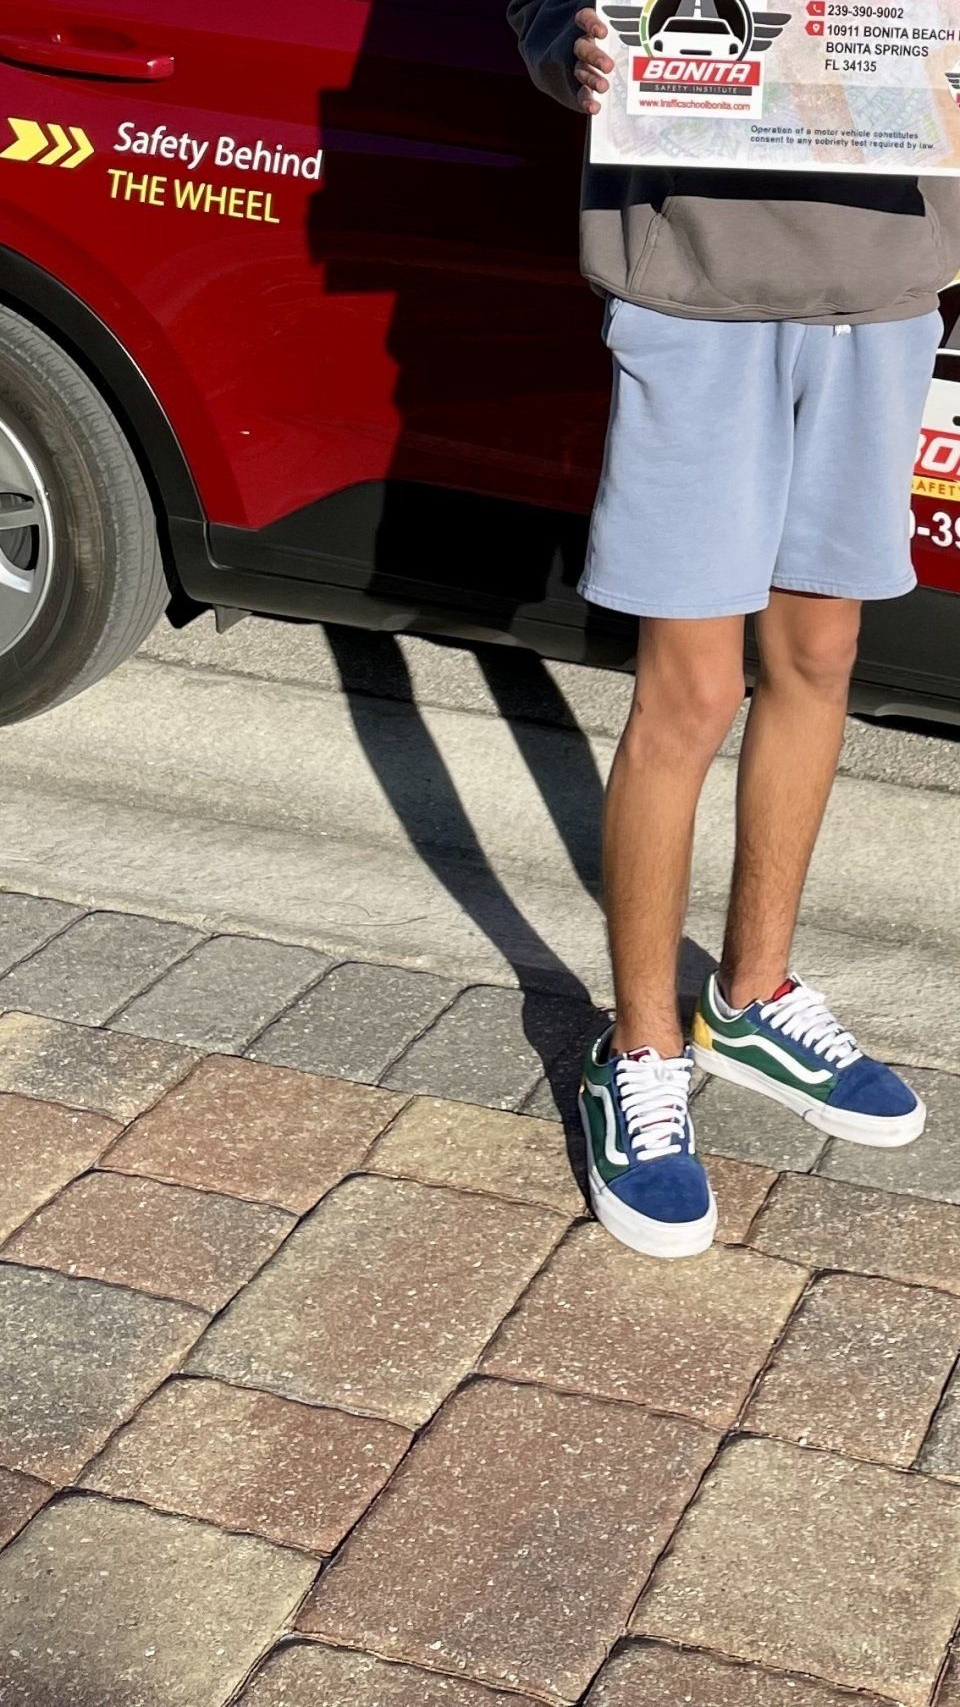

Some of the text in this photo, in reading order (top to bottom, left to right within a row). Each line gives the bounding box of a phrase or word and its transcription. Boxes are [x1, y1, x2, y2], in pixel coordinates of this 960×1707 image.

[827, 4, 904, 19] 239-390-9002
[827, 25, 859, 38] 10911
[863, 26, 909, 40] BONITA
[912, 28, 955, 42] BEACH
[826, 42, 929, 57] BONITA SPRINGS
[642, 60, 752, 83] BONITA
[825, 59, 877, 72] FL 34135
[654, 84, 738, 94] SAFETY INSTITUTE
[639, 98, 751, 111] www.trafficschoolbonita.com
[751, 125, 793, 134] Operation
[795, 127, 804, 135] of
[814, 128, 838, 136] motor
[841, 129, 871, 138] vehicle
[873, 130, 919, 140] constitutes
[750, 135, 784, 144] consent
[815, 137, 849, 148] sobriety
[851, 139, 867, 147] test
[869, 140, 905, 150] required
[906, 141, 917, 150] by
[113, 121, 324, 180] Safety Behind
[106, 168, 280, 224] THE WHEEL
